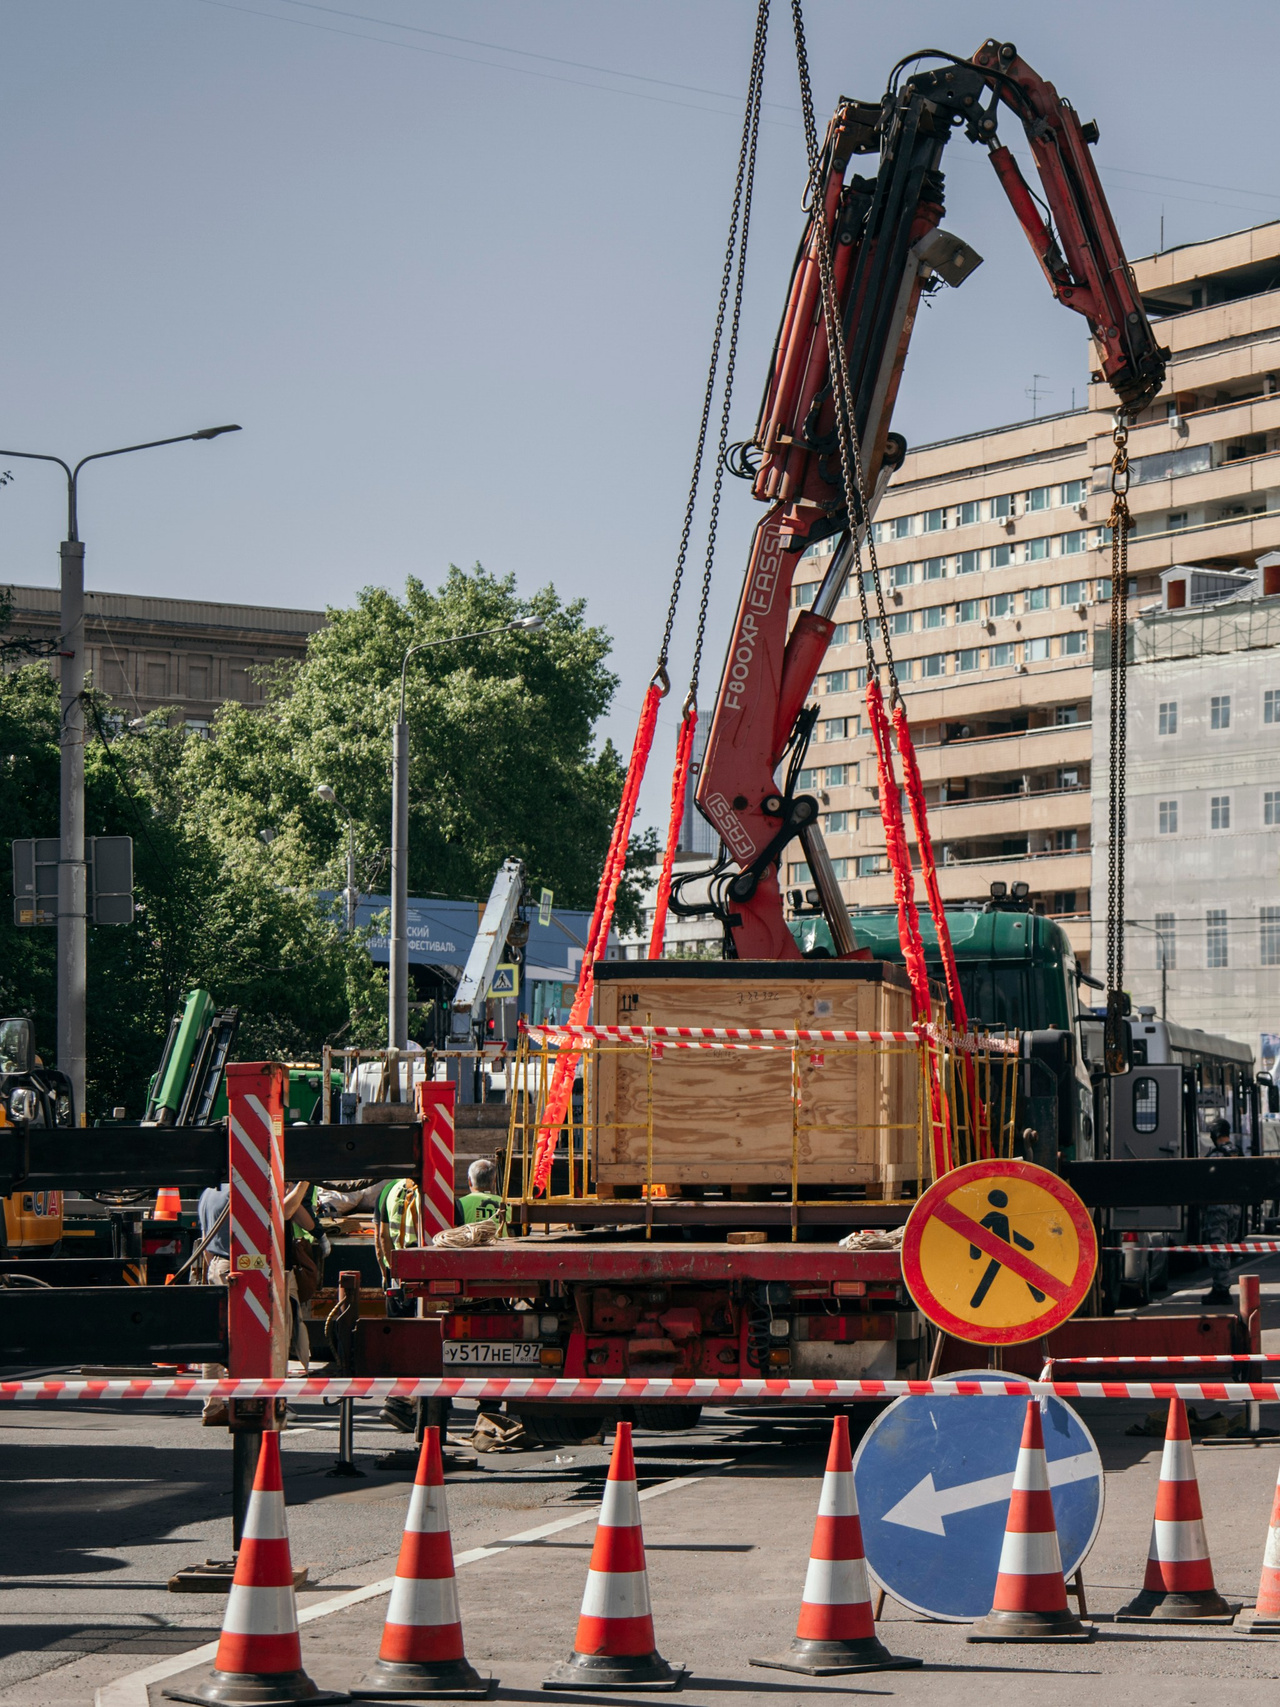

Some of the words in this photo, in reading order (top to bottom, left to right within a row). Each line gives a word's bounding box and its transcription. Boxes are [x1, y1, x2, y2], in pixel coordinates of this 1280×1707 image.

[751, 530, 781, 609] FASSI
[724, 613, 759, 710] F800XP
[709, 797, 752, 855] FASSI
[515, 1344, 539, 1357] 797
